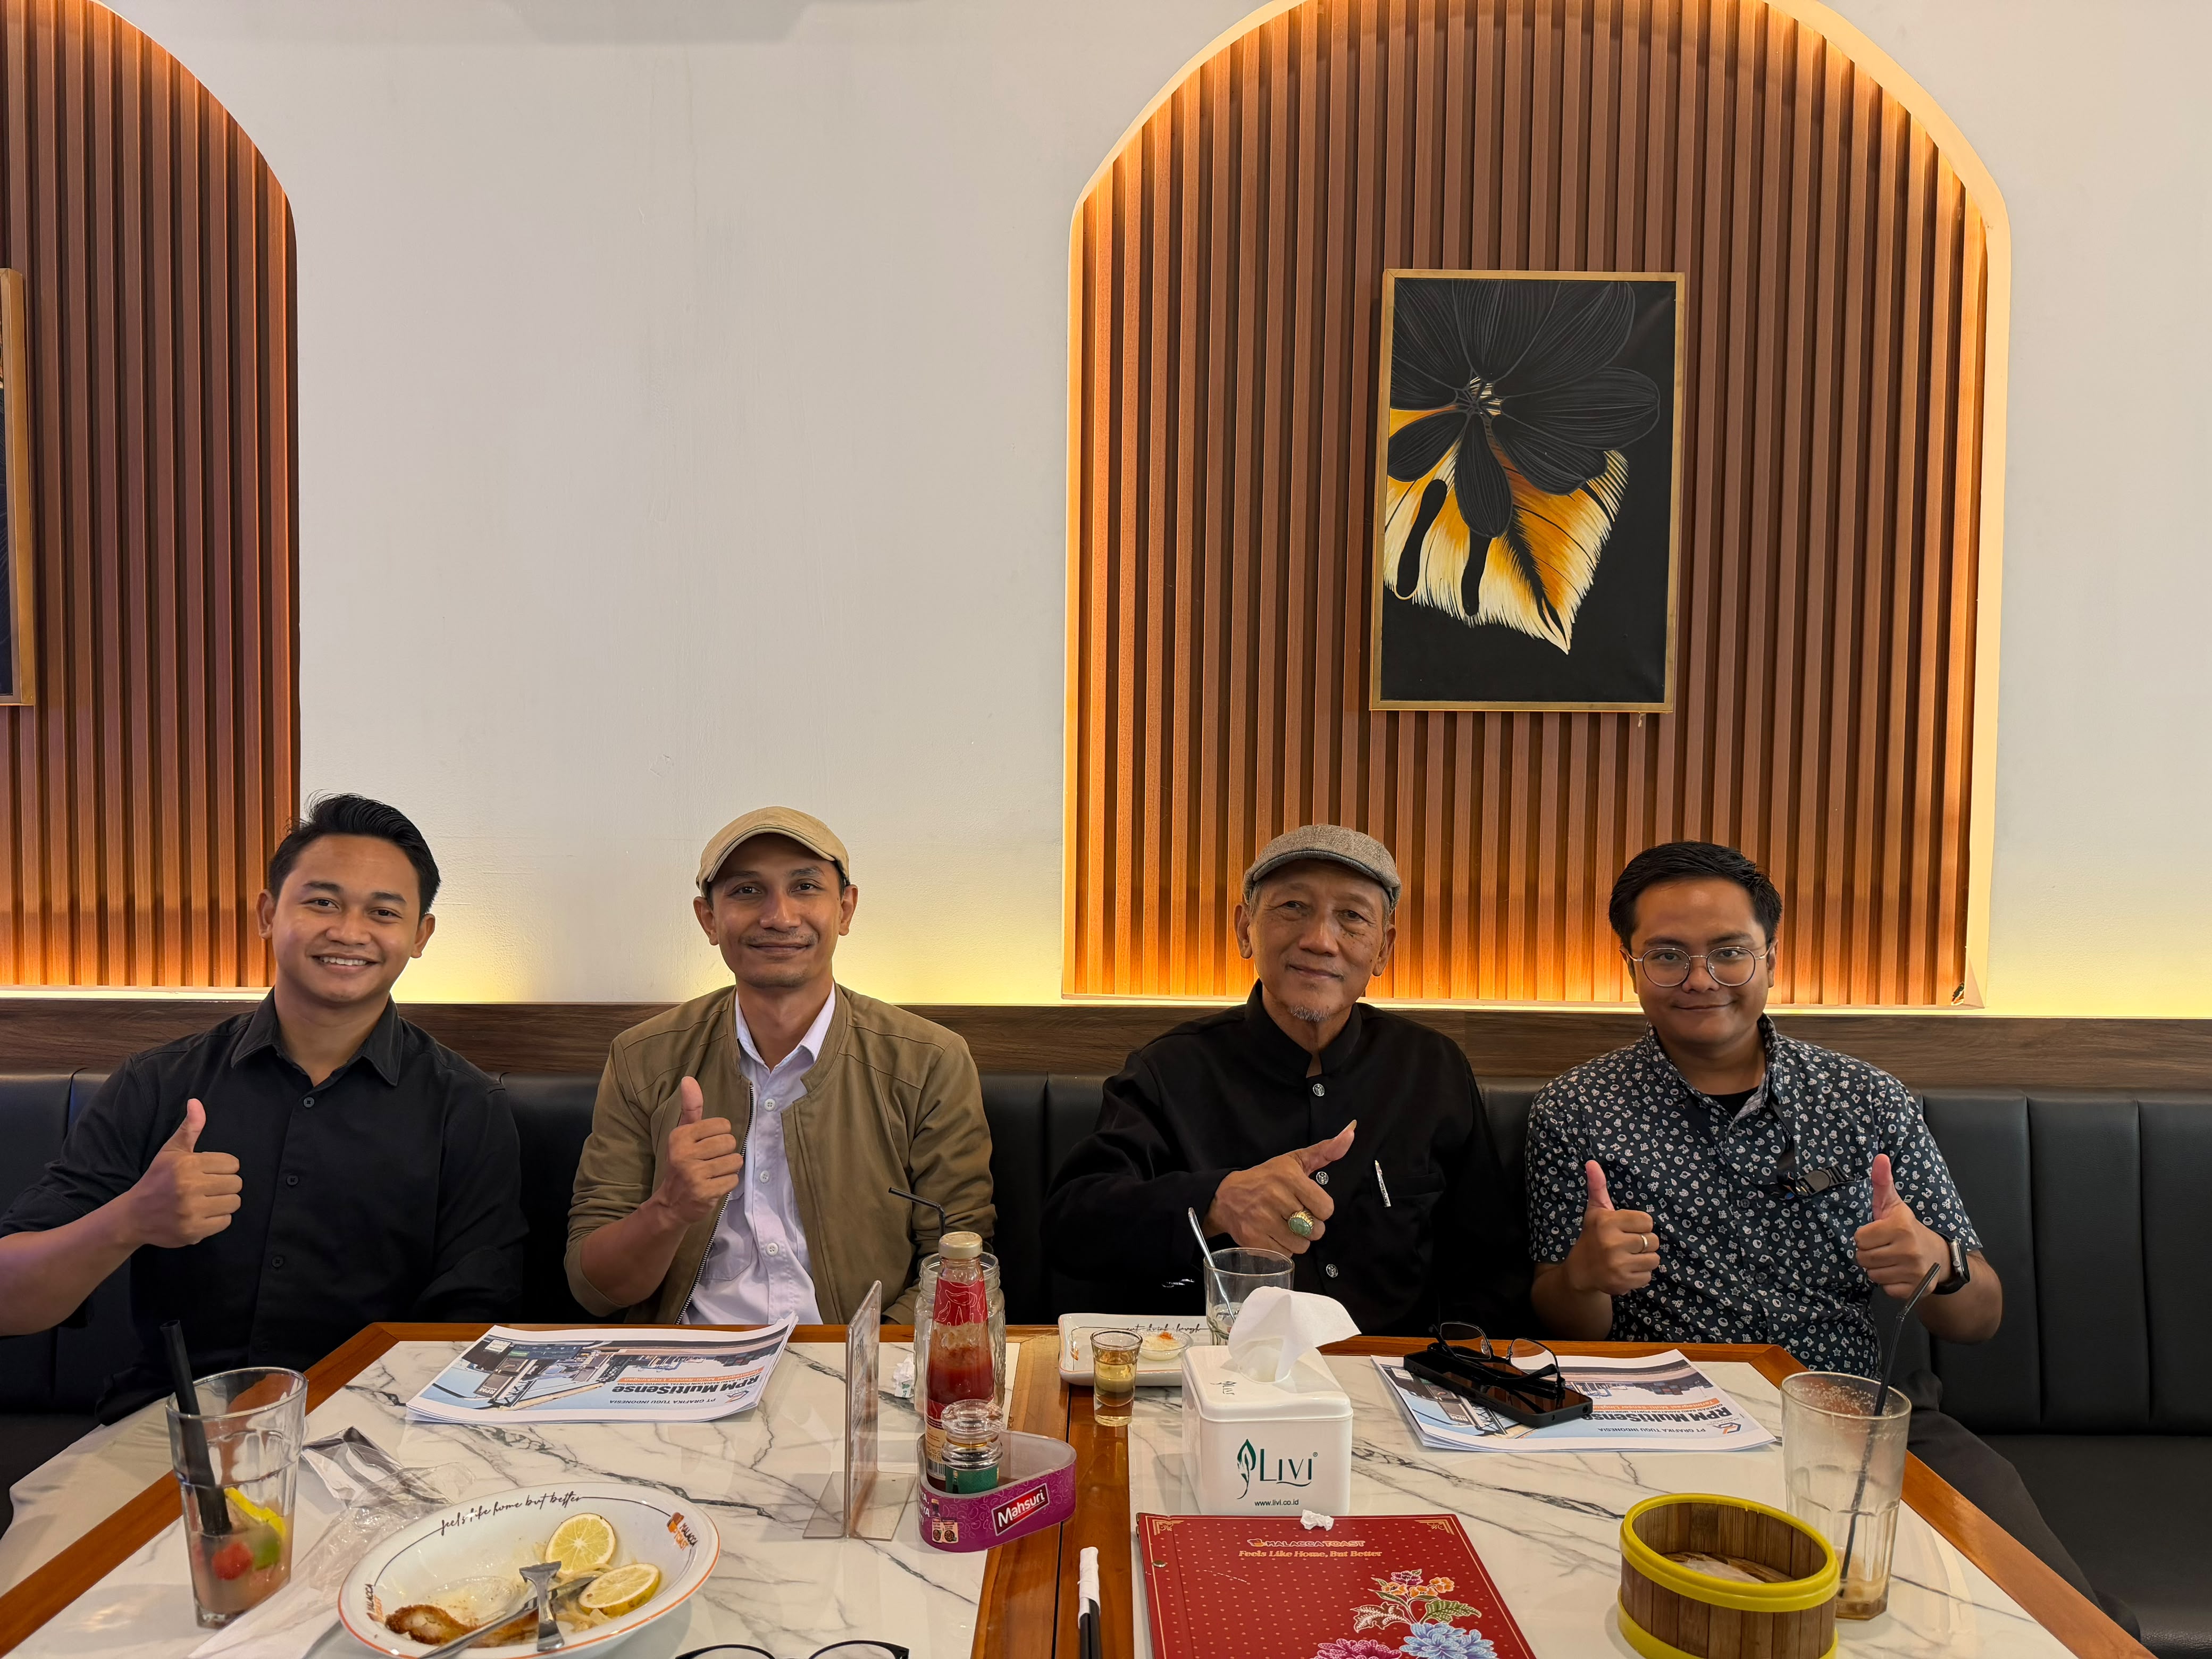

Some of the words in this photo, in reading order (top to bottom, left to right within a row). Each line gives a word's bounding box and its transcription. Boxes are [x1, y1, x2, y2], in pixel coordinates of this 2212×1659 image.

[717, 1369, 759, 1380] Terintegrasi
[611, 1385, 718, 1394] MultiSense
[720, 1375, 760, 1392] RPM
[1671, 1401, 1715, 1410] Terintegrasi
[1697, 1403, 1723, 1412] GENERASI
[1581, 1413, 1690, 1422] MultiSense
[1688, 1406, 1732, 1421] RPM
[493, 1501, 523, 1516] home
[549, 1490, 584, 1509] better
[998, 1489, 1045, 1528] Mahsuri
[674, 1531, 689, 1551] TOAST
[679, 1522, 698, 1547] MALACCA
